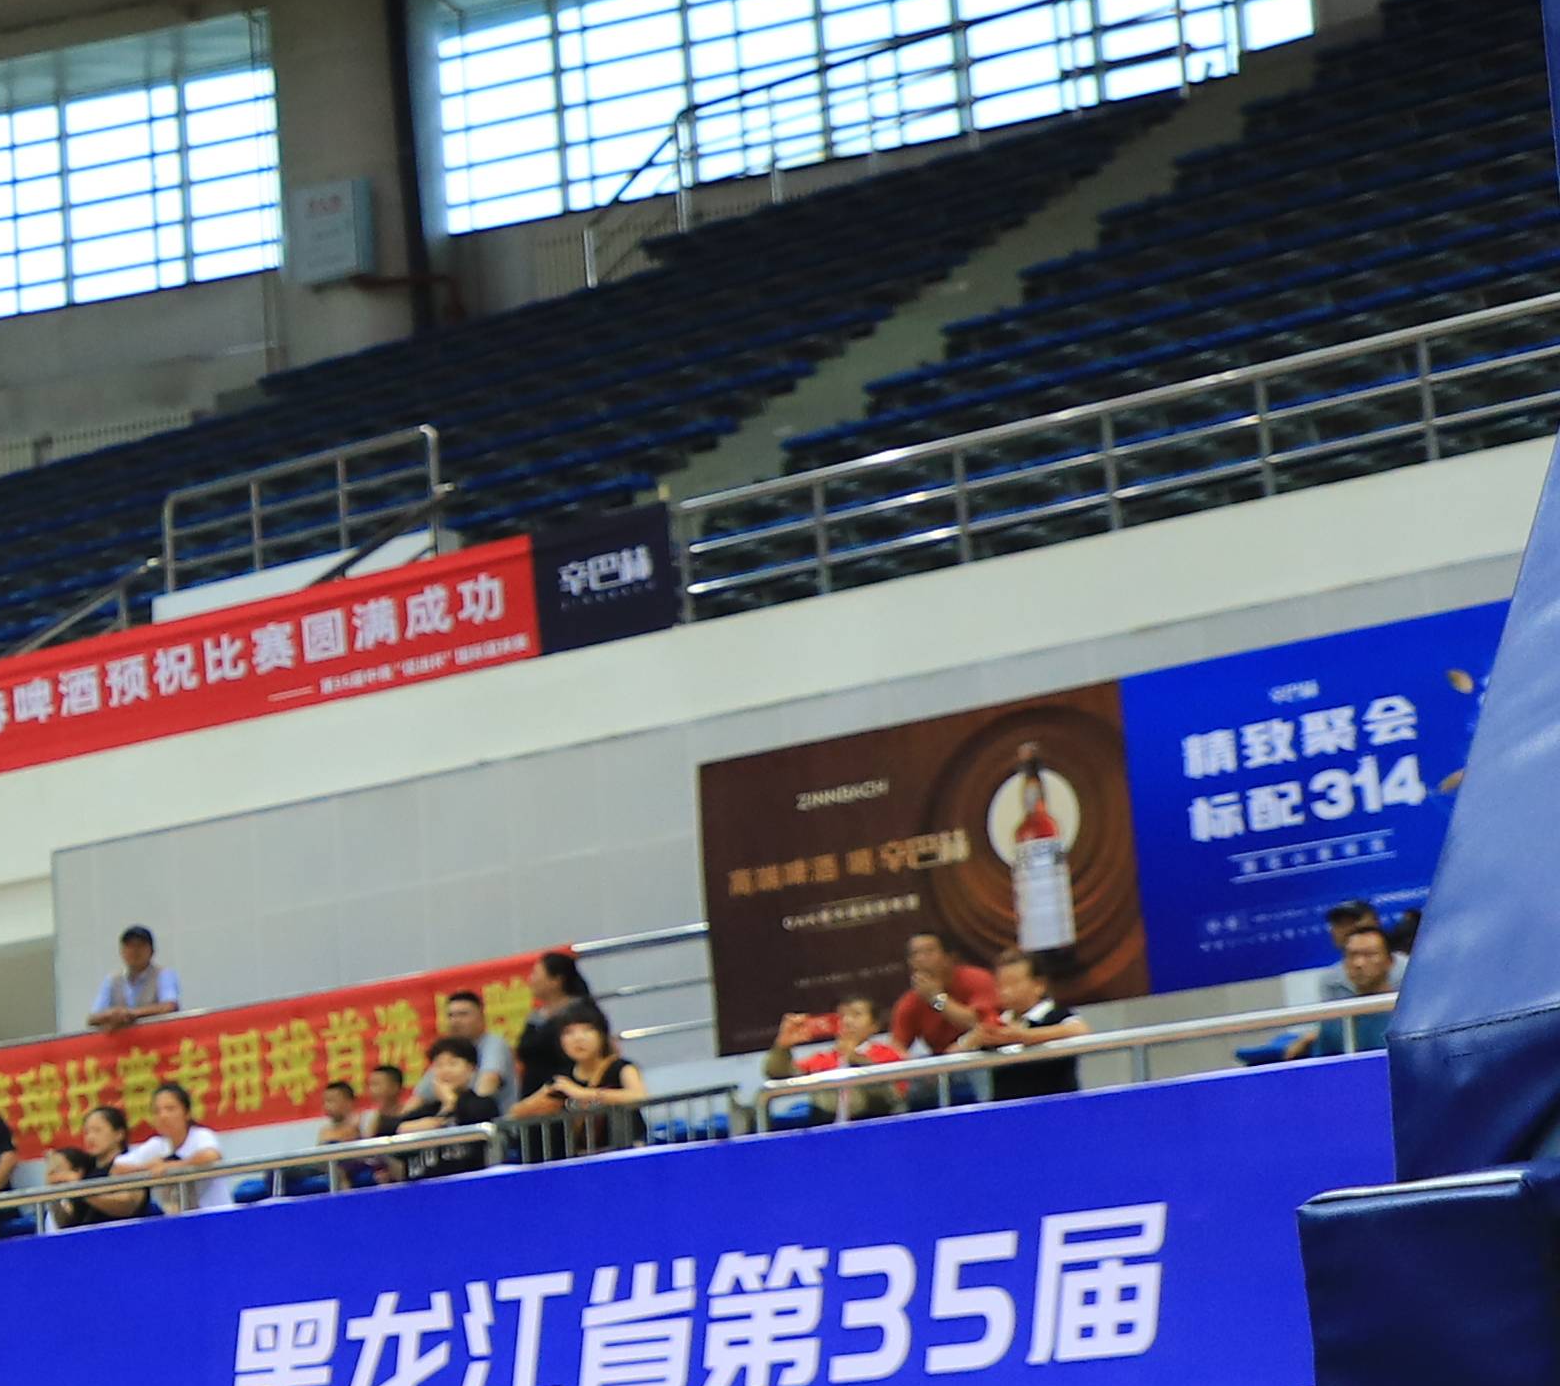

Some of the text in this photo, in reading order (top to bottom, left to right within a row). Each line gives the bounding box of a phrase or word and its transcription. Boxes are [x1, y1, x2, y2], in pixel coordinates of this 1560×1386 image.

[559, 544, 655, 598] 辛巴赫
[1187, 753, 1427, 843] 标配314
